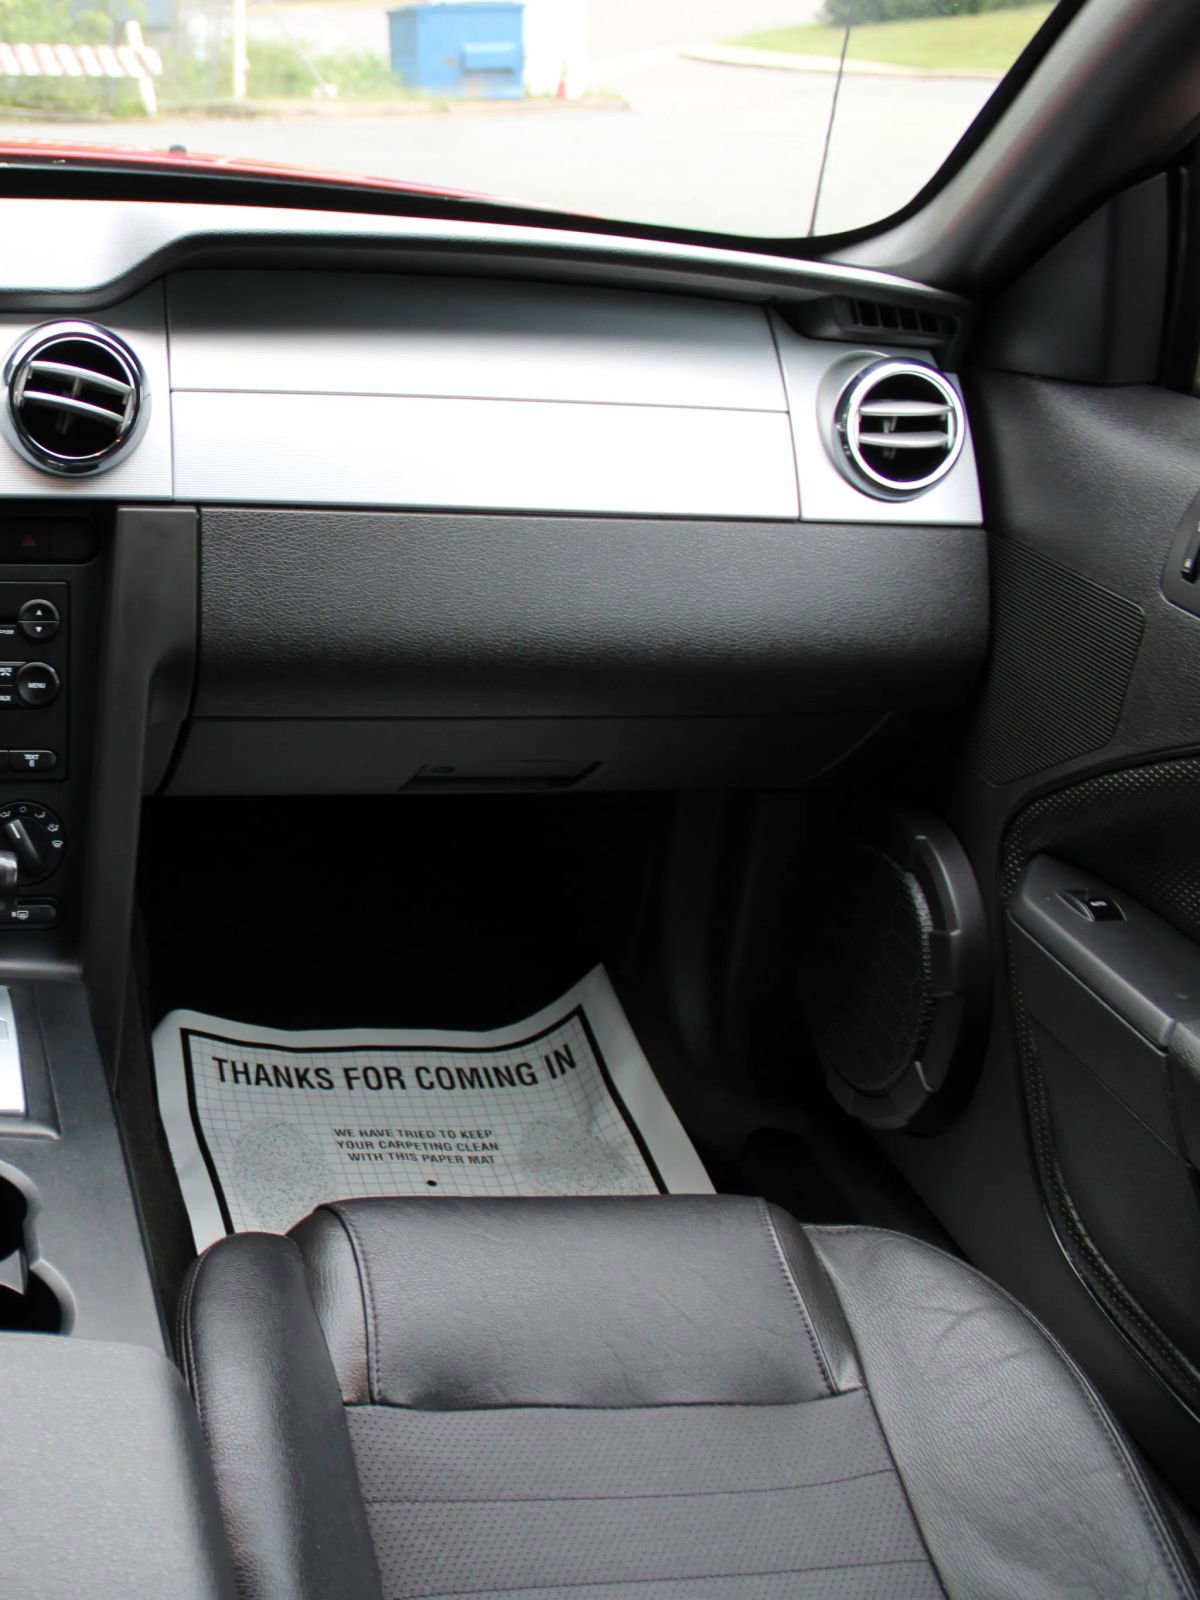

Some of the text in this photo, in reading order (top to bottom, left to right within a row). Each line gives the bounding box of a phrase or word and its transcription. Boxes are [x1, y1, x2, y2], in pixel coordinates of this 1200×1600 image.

[29, 759, 35, 767] 6
[212, 1044, 577, 1091] THANKS FOR COMING IN
[334, 1128, 493, 1139] WE HAVE TRIED TO KEEP
[336, 1140, 500, 1152] YOUR CARPETING CLEAN
[348, 1152, 496, 1165] WITH THIS PAPER MAT
